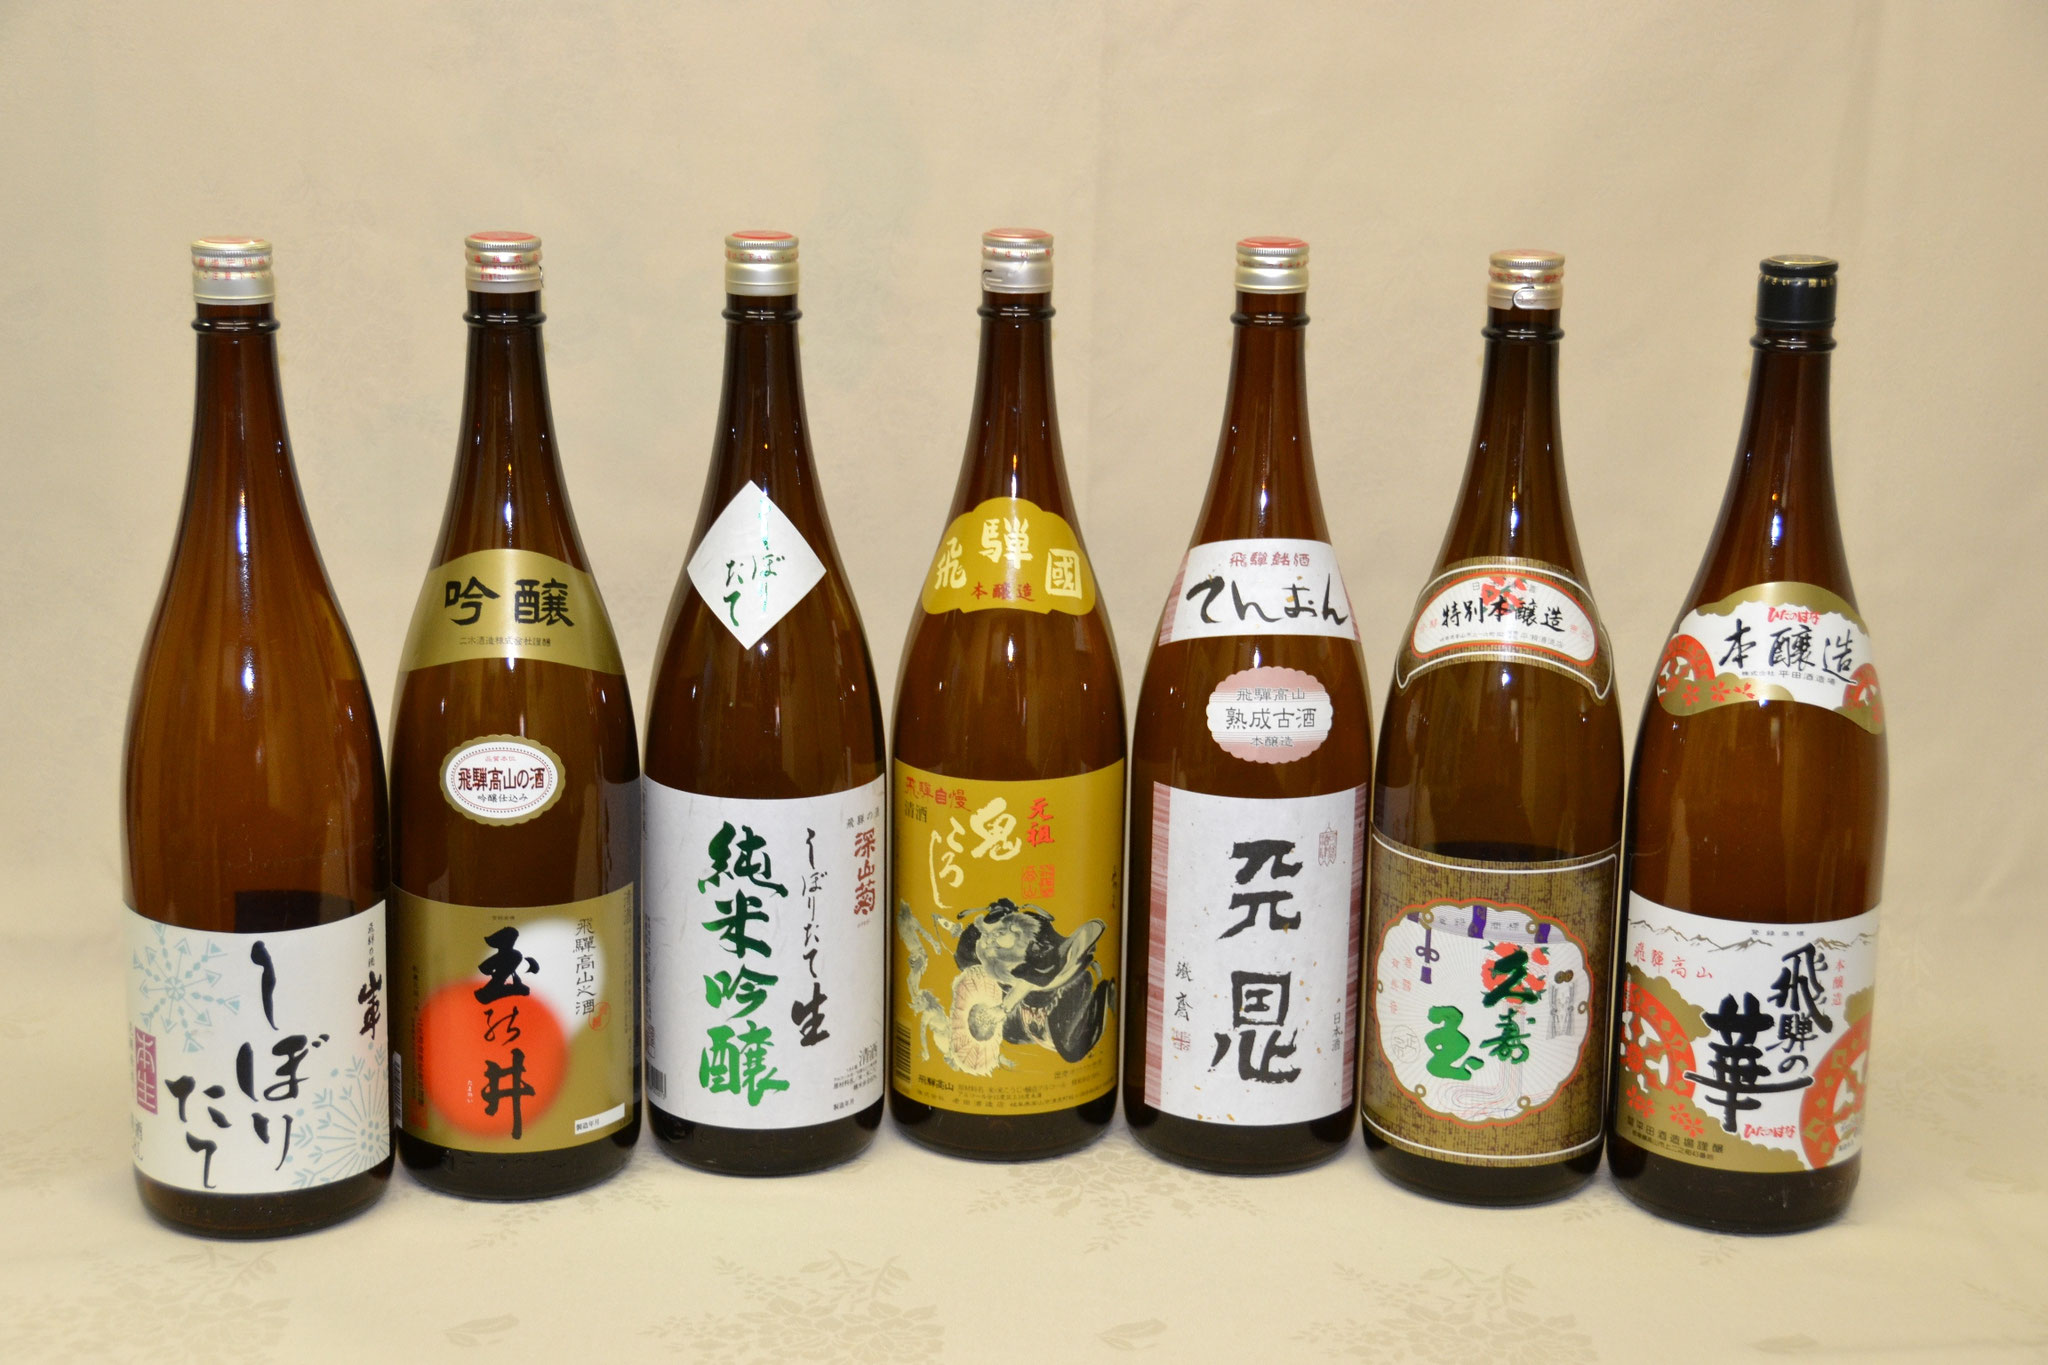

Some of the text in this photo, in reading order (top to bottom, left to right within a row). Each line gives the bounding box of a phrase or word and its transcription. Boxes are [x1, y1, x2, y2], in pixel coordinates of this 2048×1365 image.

[444, 576, 575, 627] 吟醸
[1441, 597, 1565, 632] 特別本醸造
[1719, 619, 1858, 684] 本醸造
[1225, 707, 1317, 730] 熟成古酒
[458, 767, 545, 791] 飛騨高山の酒
[1026, 796, 1055, 848] 元祖
[697, 820, 790, 1107] 純米吟醸
